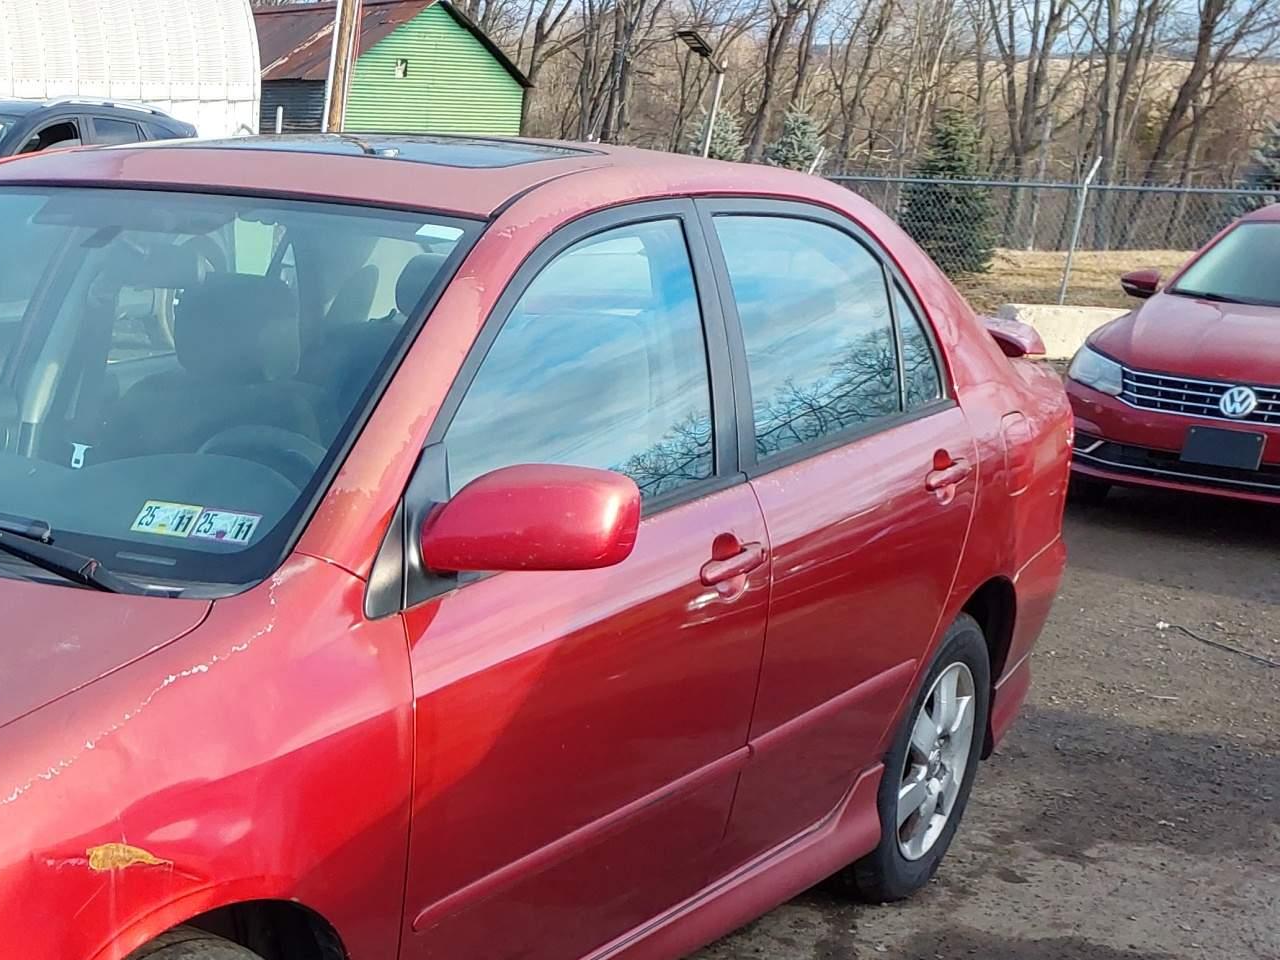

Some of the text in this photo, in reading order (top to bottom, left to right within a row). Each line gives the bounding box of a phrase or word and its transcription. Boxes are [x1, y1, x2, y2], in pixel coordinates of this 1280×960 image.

[139, 505, 193, 533] 25 11
[196, 512, 253, 540] 25 11
